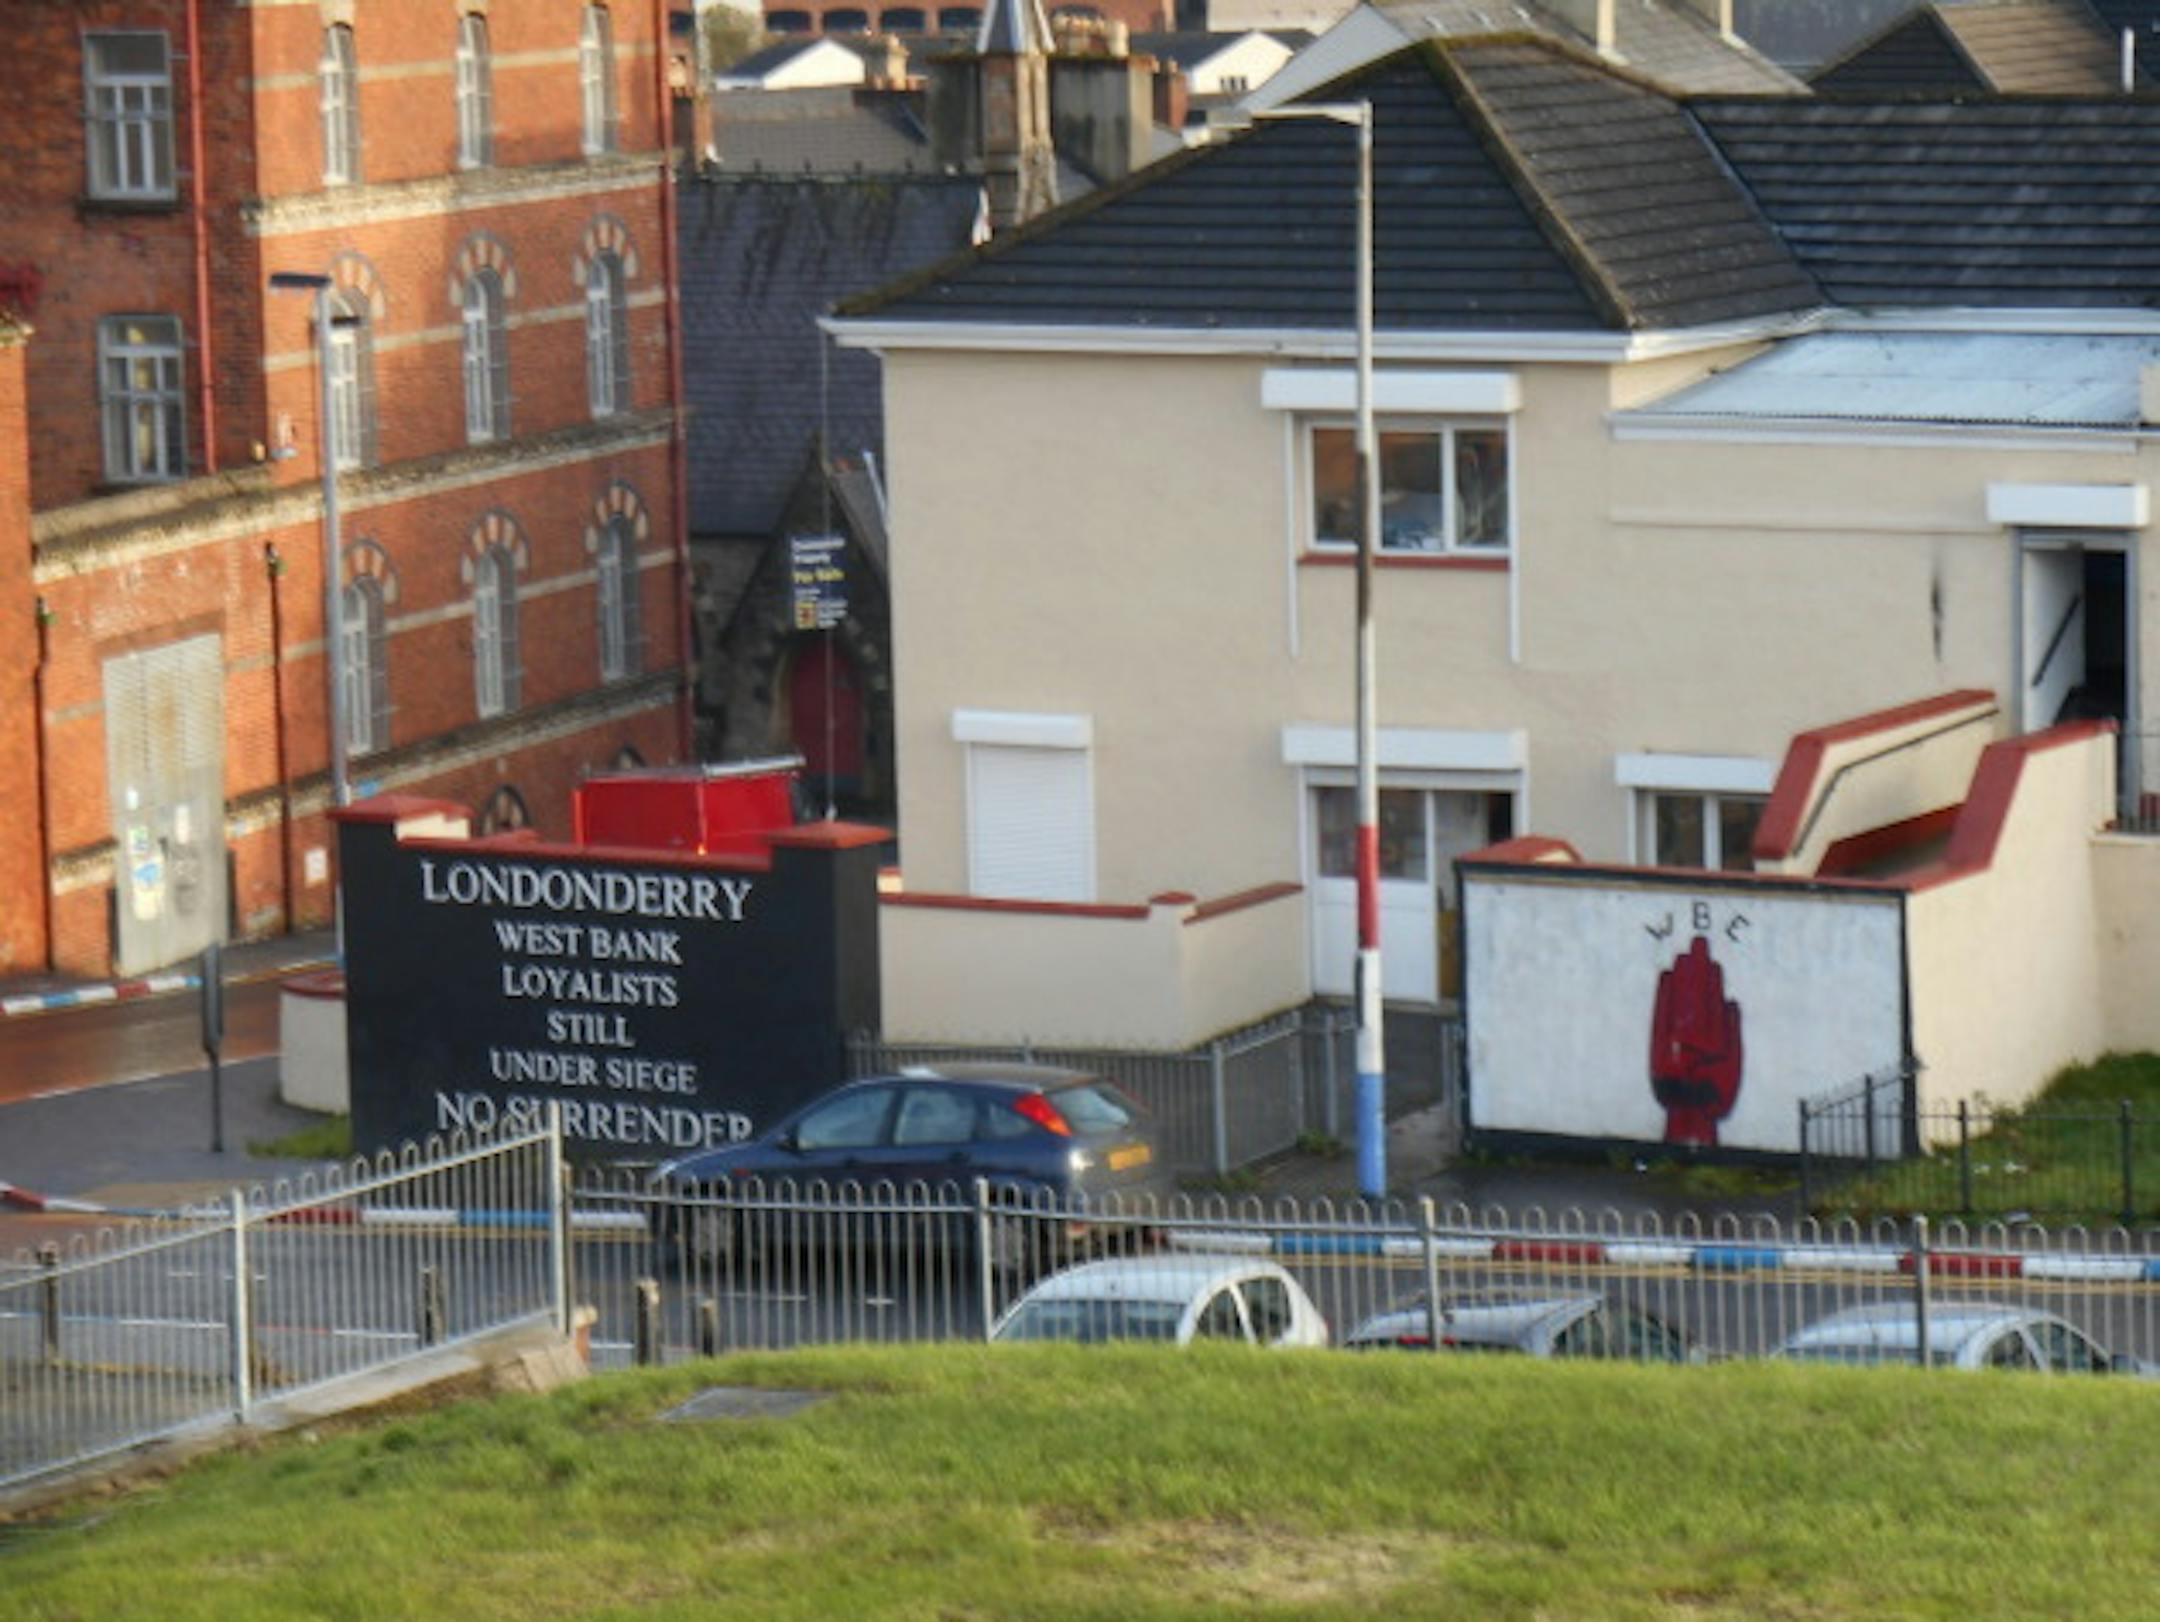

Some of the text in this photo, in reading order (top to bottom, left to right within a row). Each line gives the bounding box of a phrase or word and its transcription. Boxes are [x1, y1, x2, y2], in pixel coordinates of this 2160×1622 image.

[421, 861, 753, 921] LONDONDERRY
[495, 921, 683, 965] WEST BANK
[503, 967, 678, 1007] LOYALISTS
[548, 1012, 636, 1048] STILL
[490, 1049, 698, 1094] UNDER SIEGE
[435, 1092, 496, 1131] NO
